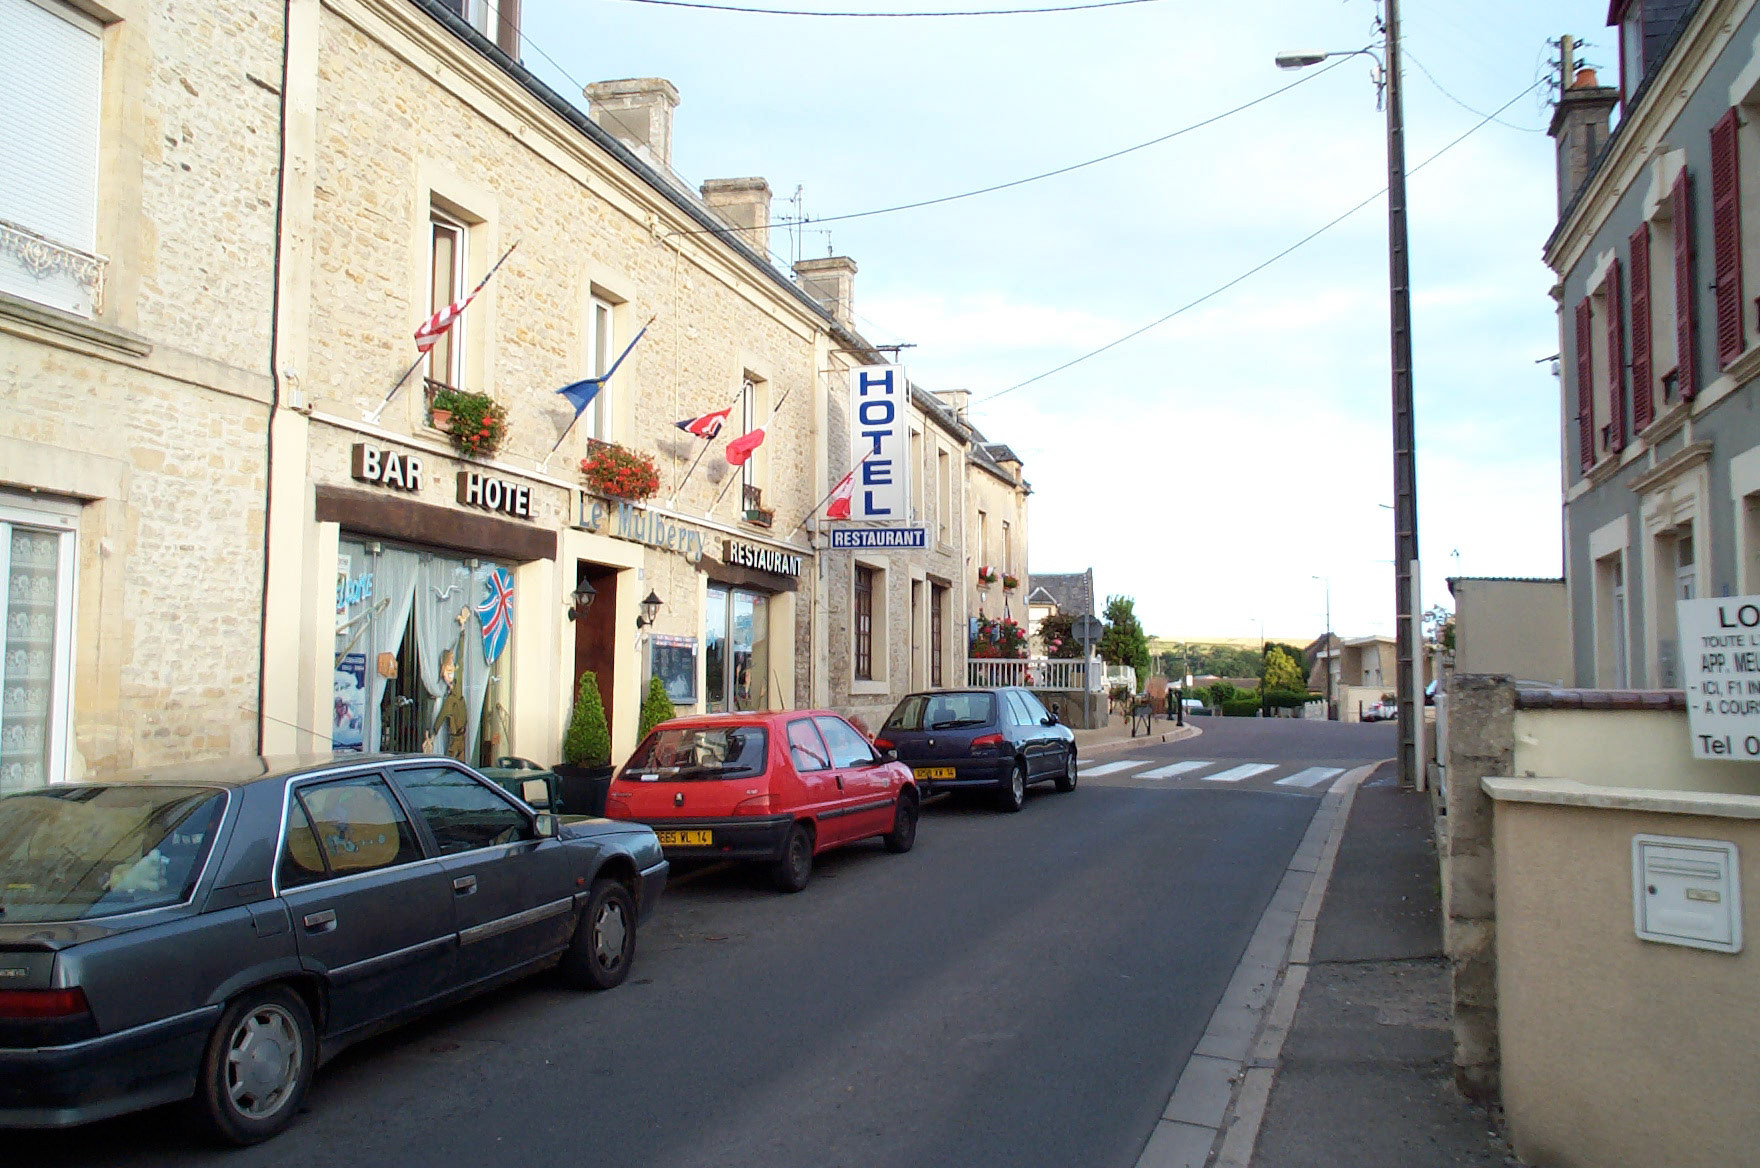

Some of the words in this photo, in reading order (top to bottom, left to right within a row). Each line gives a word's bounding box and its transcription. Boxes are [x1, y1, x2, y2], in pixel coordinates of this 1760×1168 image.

[859, 370, 895, 516] HOTEL
[363, 443, 424, 491] BAR
[466, 471, 539, 518] HOTEL
[579, 490, 603, 529] Le
[618, 501, 706, 561] Mulberry
[834, 530, 922, 547] RESTAURANT
[731, 540, 802, 577] RESTAURANT
[1701, 634, 1745, 648] TOUTE
[1705, 701, 1714, 714] A
[1699, 735, 1731, 754] Tel
